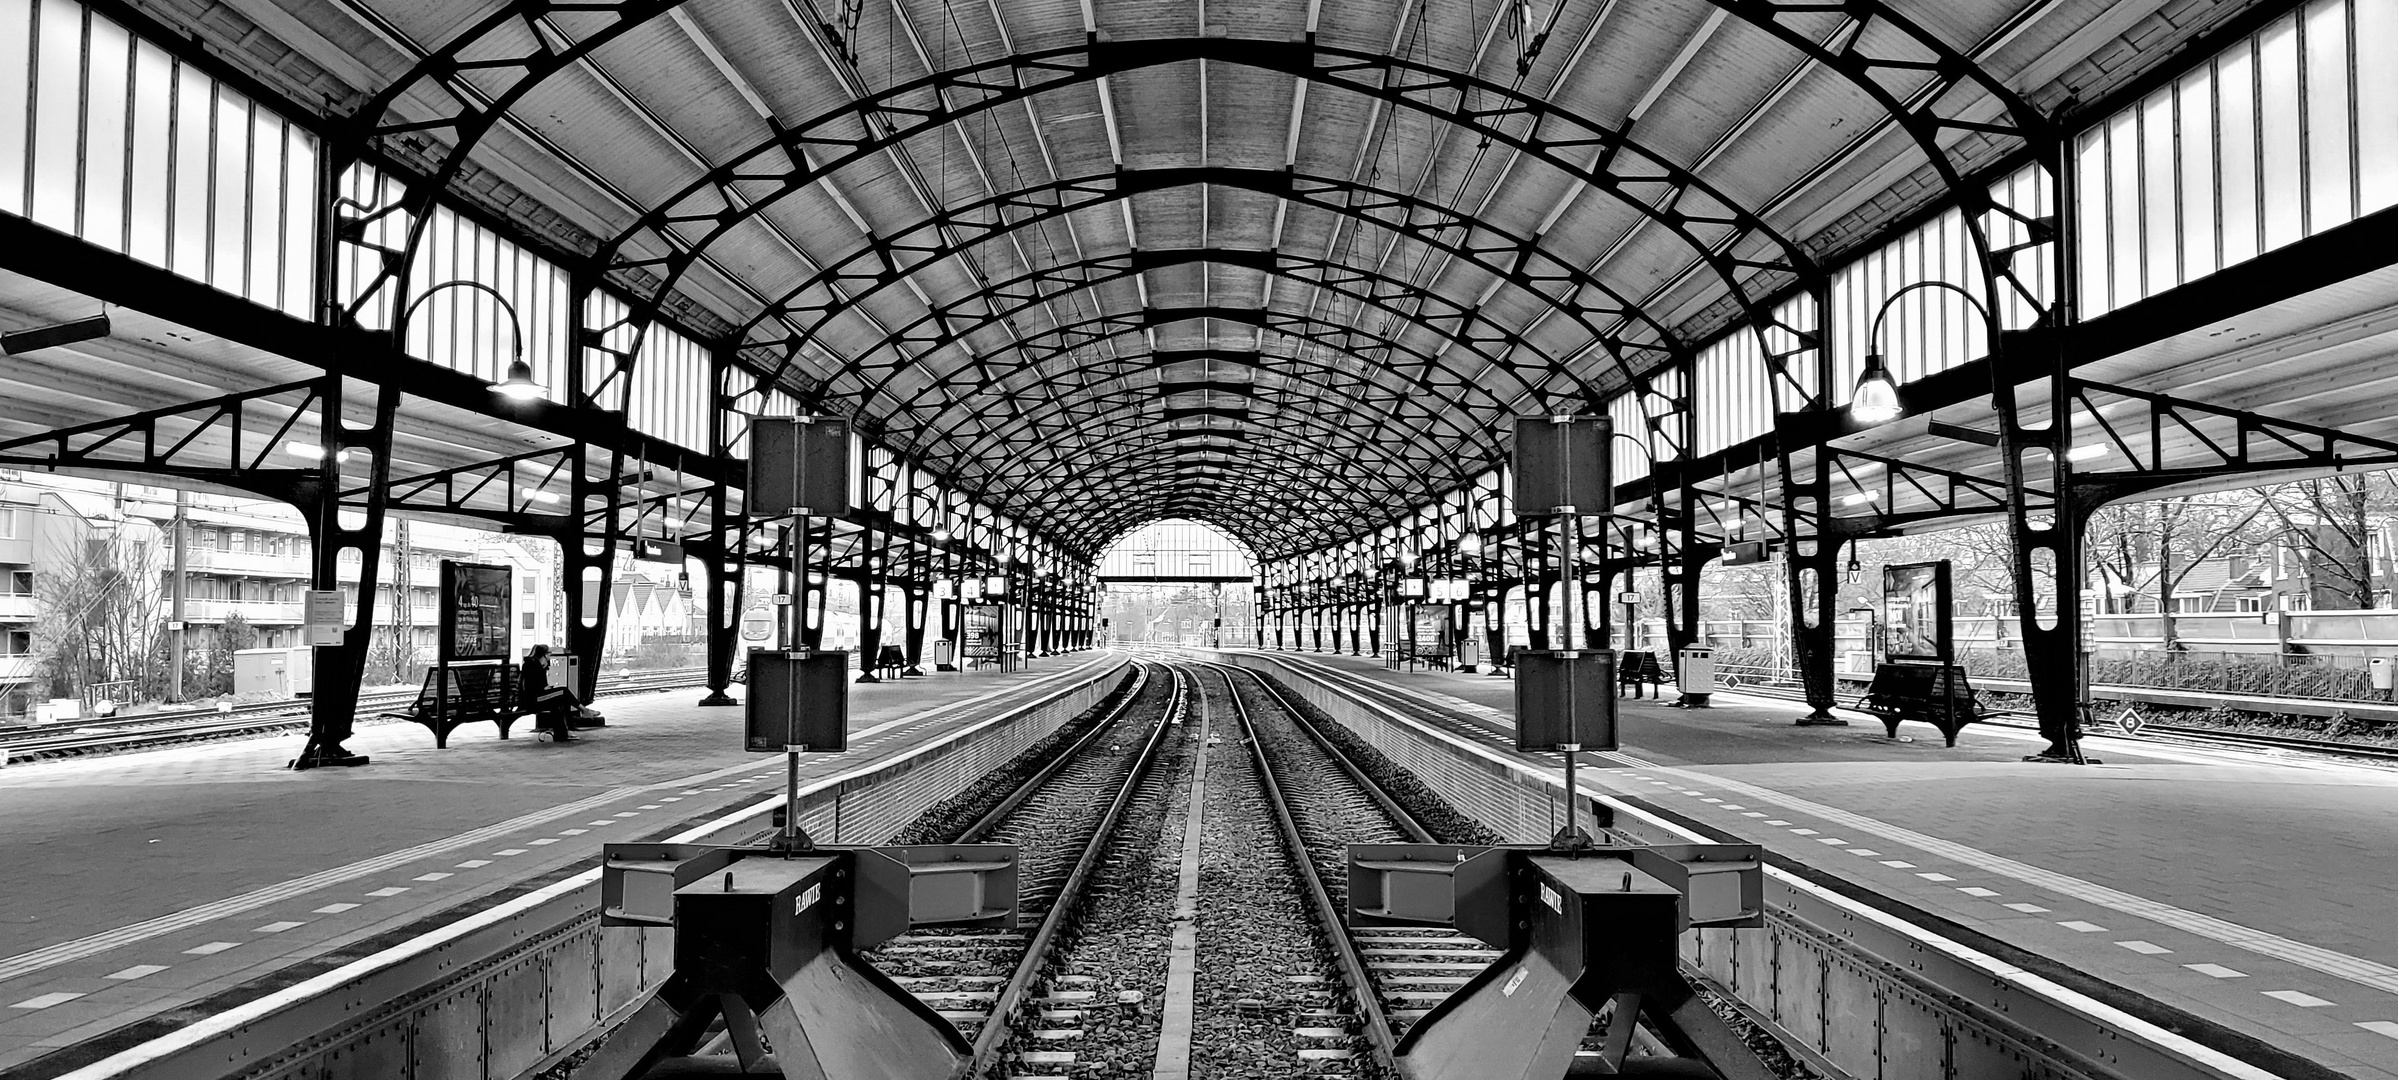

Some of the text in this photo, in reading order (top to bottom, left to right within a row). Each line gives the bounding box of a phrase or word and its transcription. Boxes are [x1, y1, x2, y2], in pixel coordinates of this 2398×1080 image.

[939, 586, 946, 597] 3
[967, 586, 973, 596] 4
[1437, 587, 1442, 597] 5
[1456, 587, 1462, 597] 6
[778, 595, 786, 603] 17
[2125, 717, 2136, 728] 8
[795, 881, 821, 916] RAWIE
[1540, 881, 1563, 915] RAWIE
